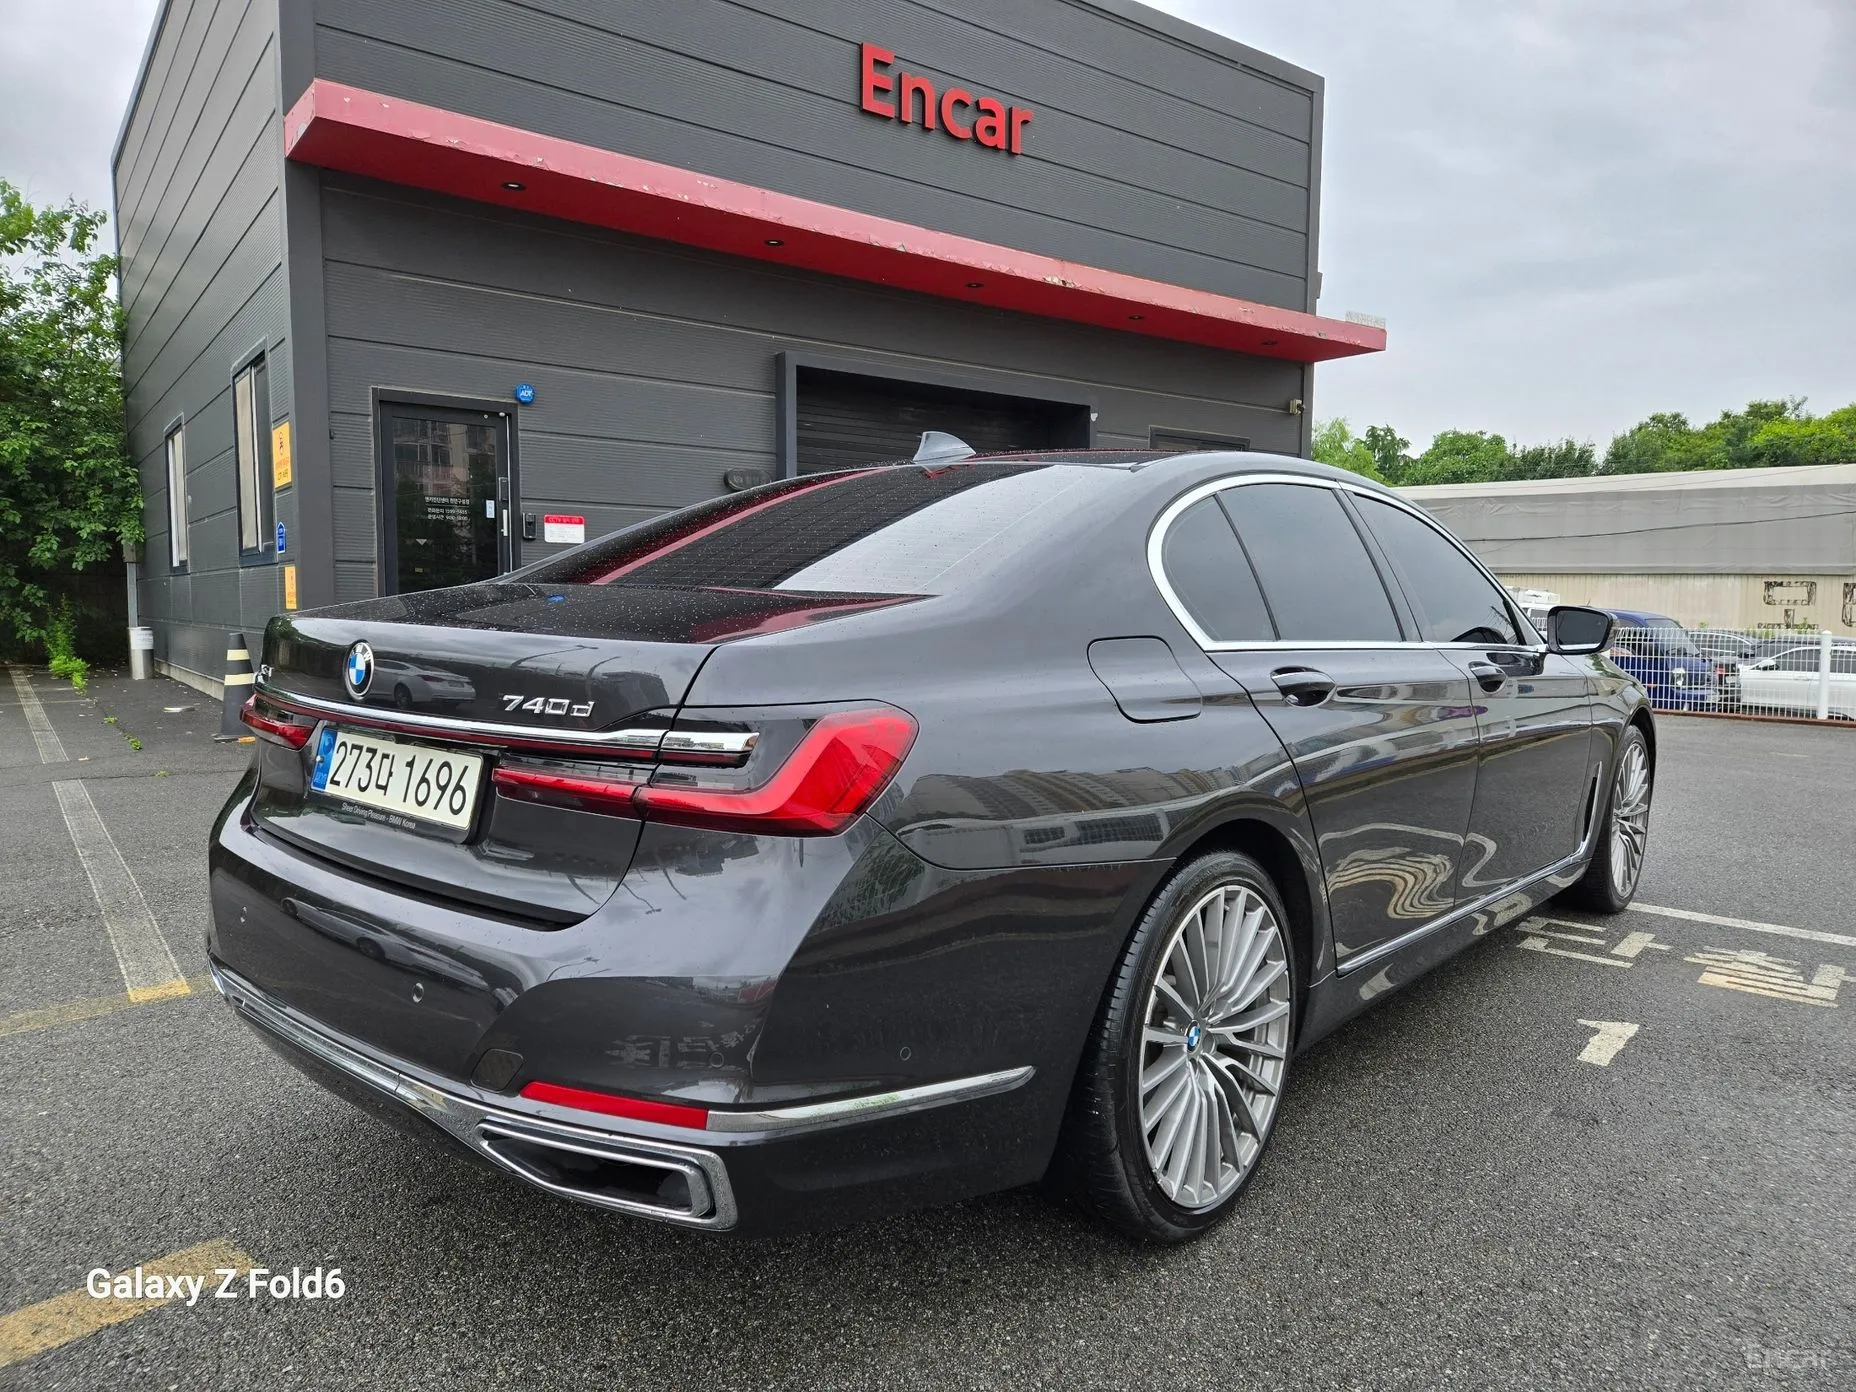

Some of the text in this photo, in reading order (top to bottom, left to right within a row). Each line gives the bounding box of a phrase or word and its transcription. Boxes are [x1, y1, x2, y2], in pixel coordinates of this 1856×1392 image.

[860, 41, 1034, 154] Encar
[502, 695, 595, 718] 740d
[329, 740, 470, 815] 273다 1696
[353, 805, 368, 817] Driving
[367, 809, 386, 822] Pleasure
[388, 815, 402, 826] BMW
[401, 819, 416, 829] Korea
[1576, 1018, 1640, 1067] 1
